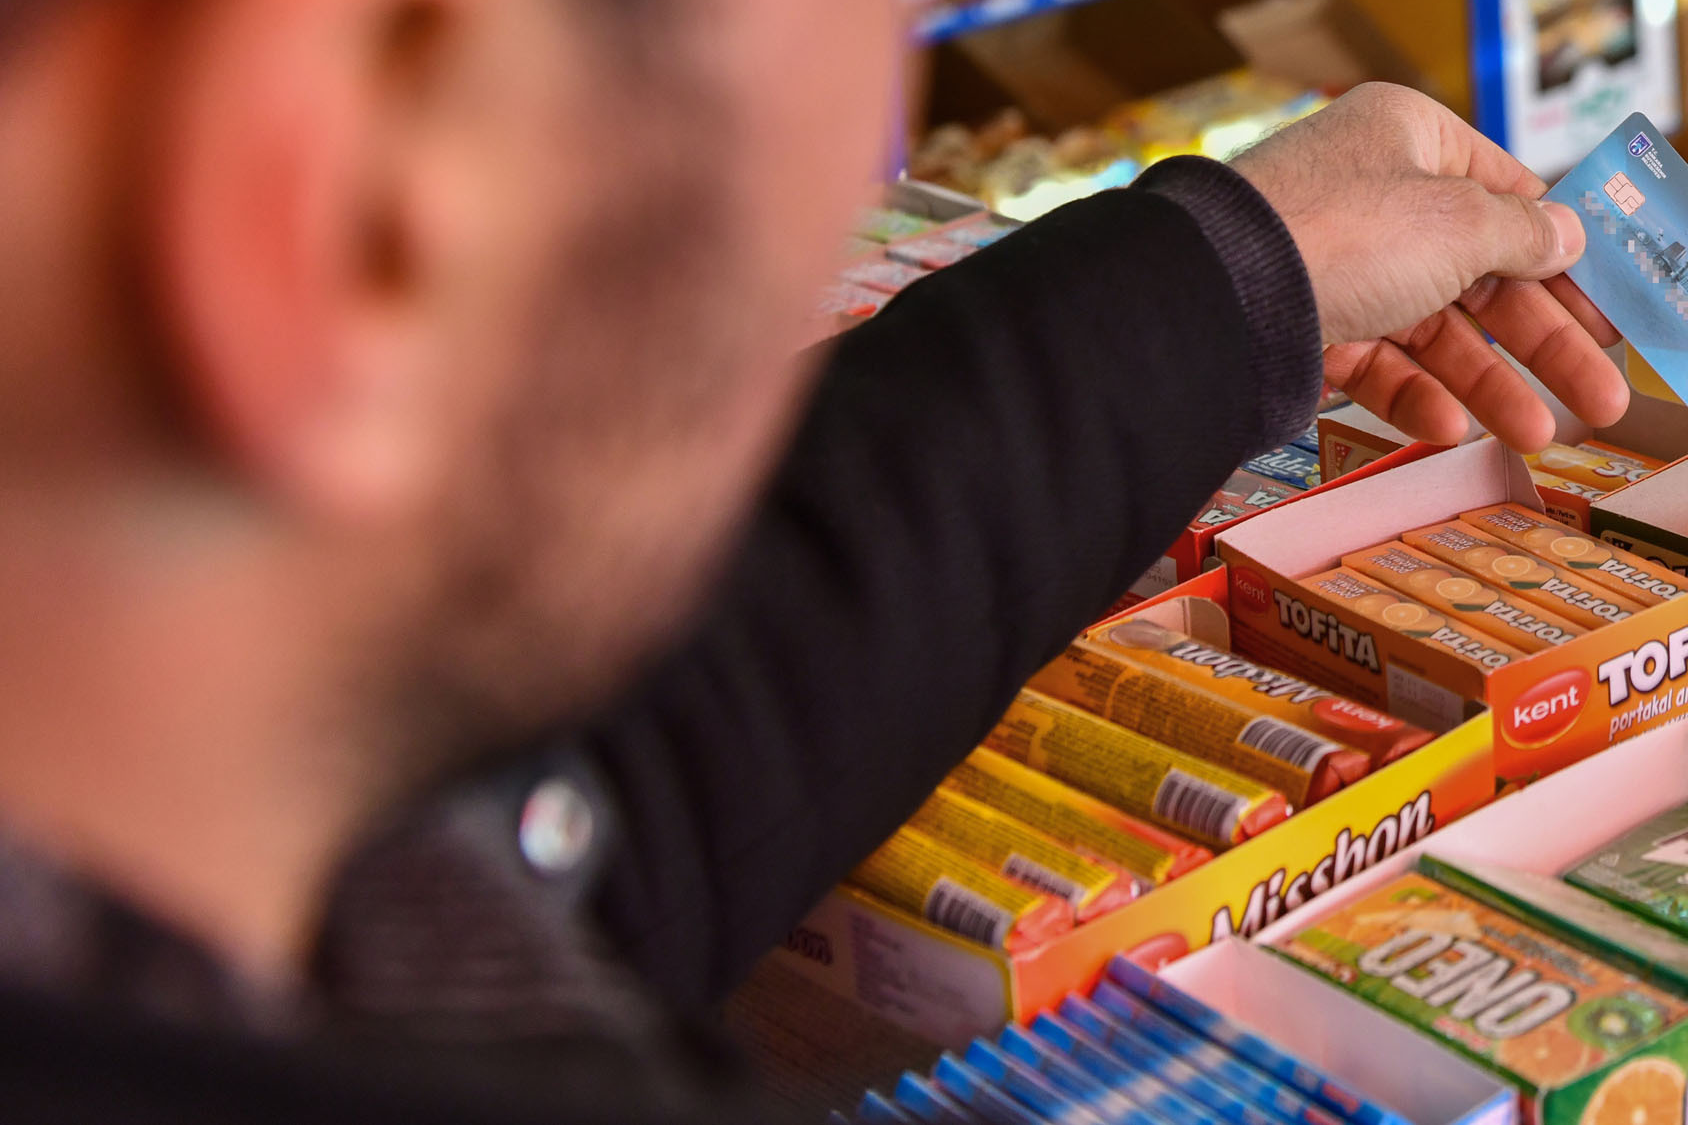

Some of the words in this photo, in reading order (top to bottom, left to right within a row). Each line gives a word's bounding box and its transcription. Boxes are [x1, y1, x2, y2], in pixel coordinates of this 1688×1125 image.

[1235, 575, 1266, 604] kent
[1430, 626, 1511, 668] OFiTA
[1331, 699, 1393, 729] kent
[1513, 685, 1580, 728] kent
[1609, 689, 1673, 742] portakal
[1358, 928, 1577, 1040] ONEO
